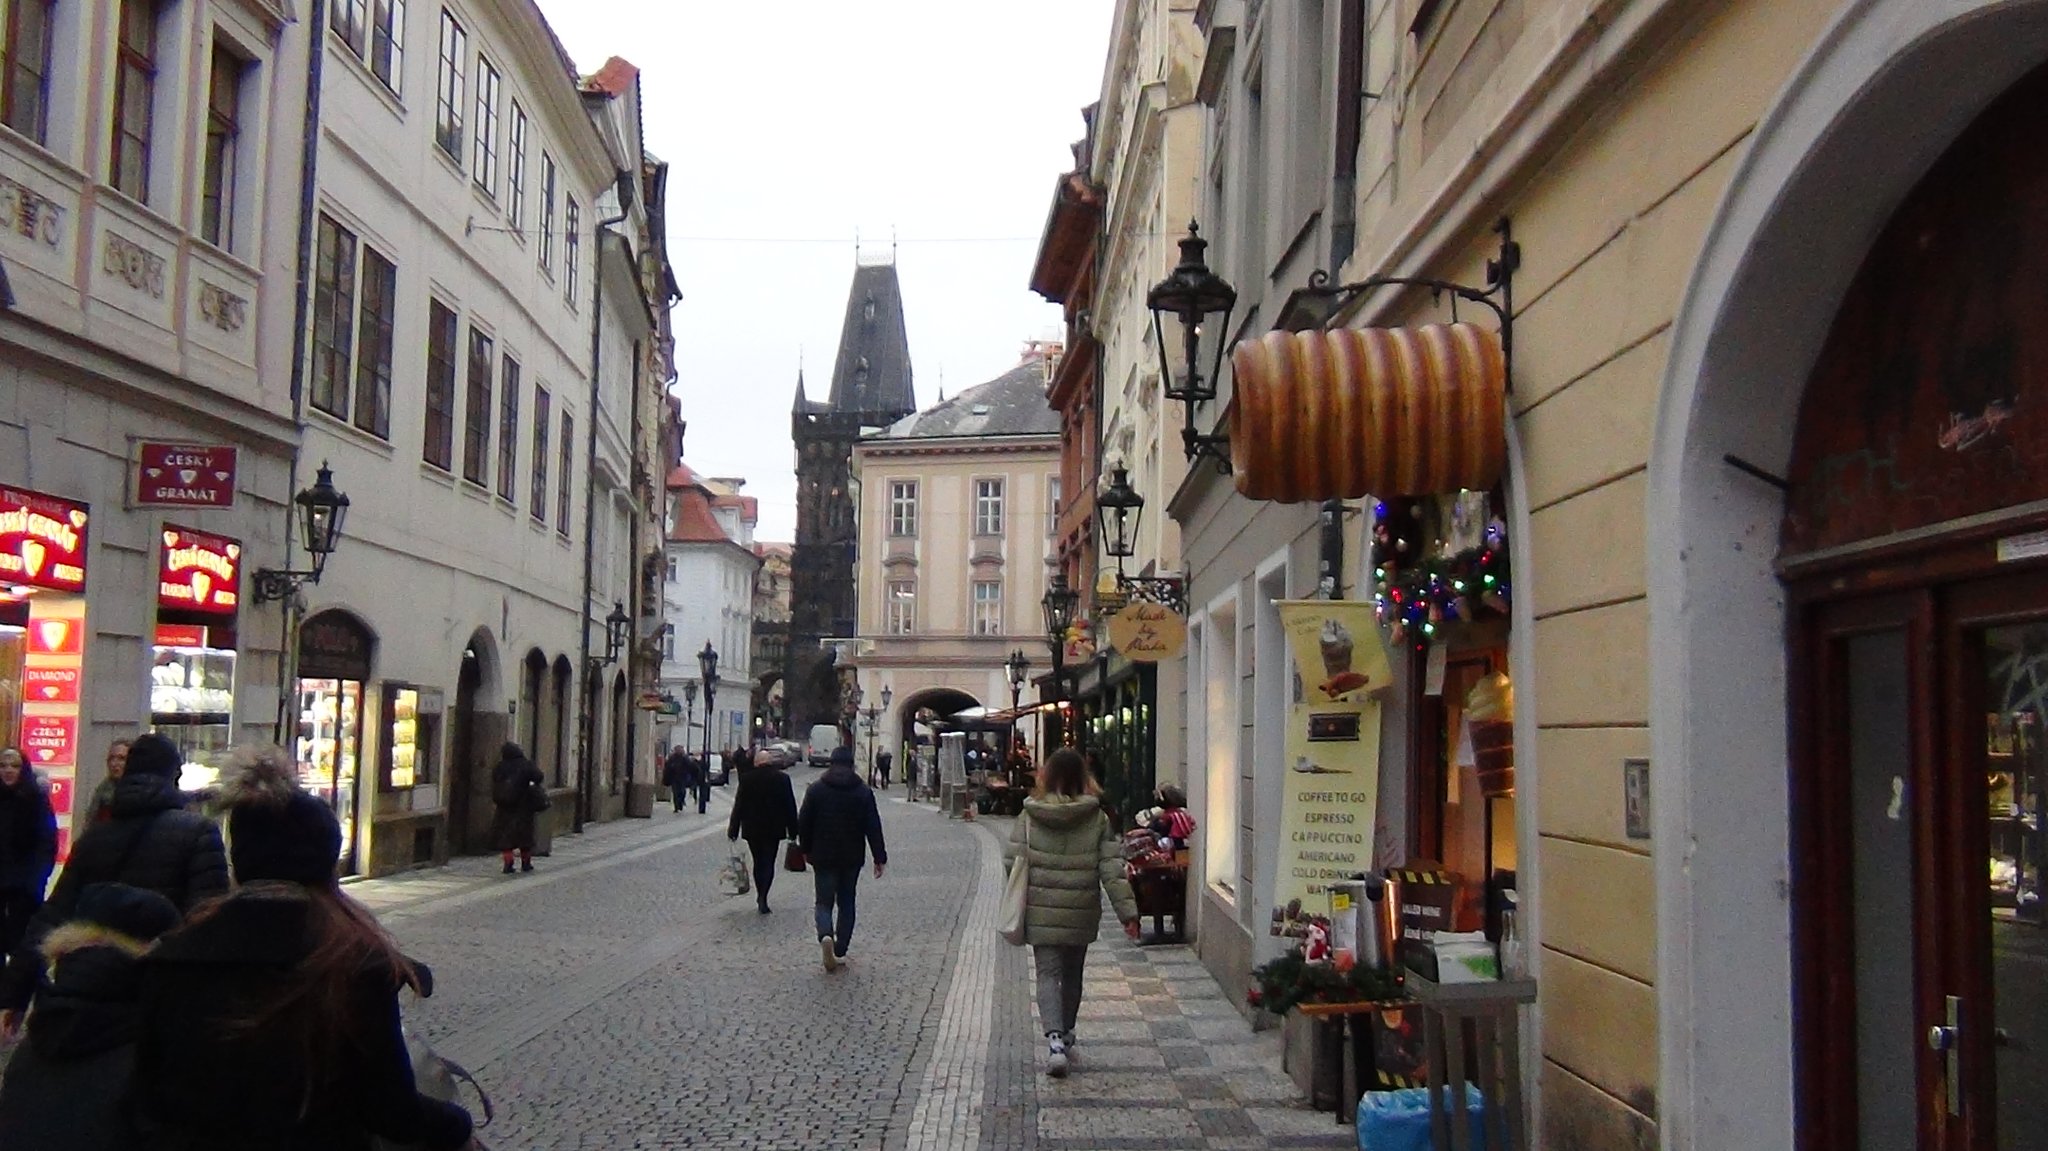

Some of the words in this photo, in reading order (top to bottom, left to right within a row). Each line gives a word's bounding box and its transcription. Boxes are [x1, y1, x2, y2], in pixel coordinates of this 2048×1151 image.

[1297, 791, 1334, 803] COFFEE
[1335, 792, 1349, 803] TO
[1350, 792, 1366, 803] GO
[1305, 812, 1355, 824] ESPRESSO
[1291, 831, 1362, 844] CAPPUCCINO
[1298, 851, 1356, 863] AMERICANO
[1291, 867, 1318, 879] COLD
